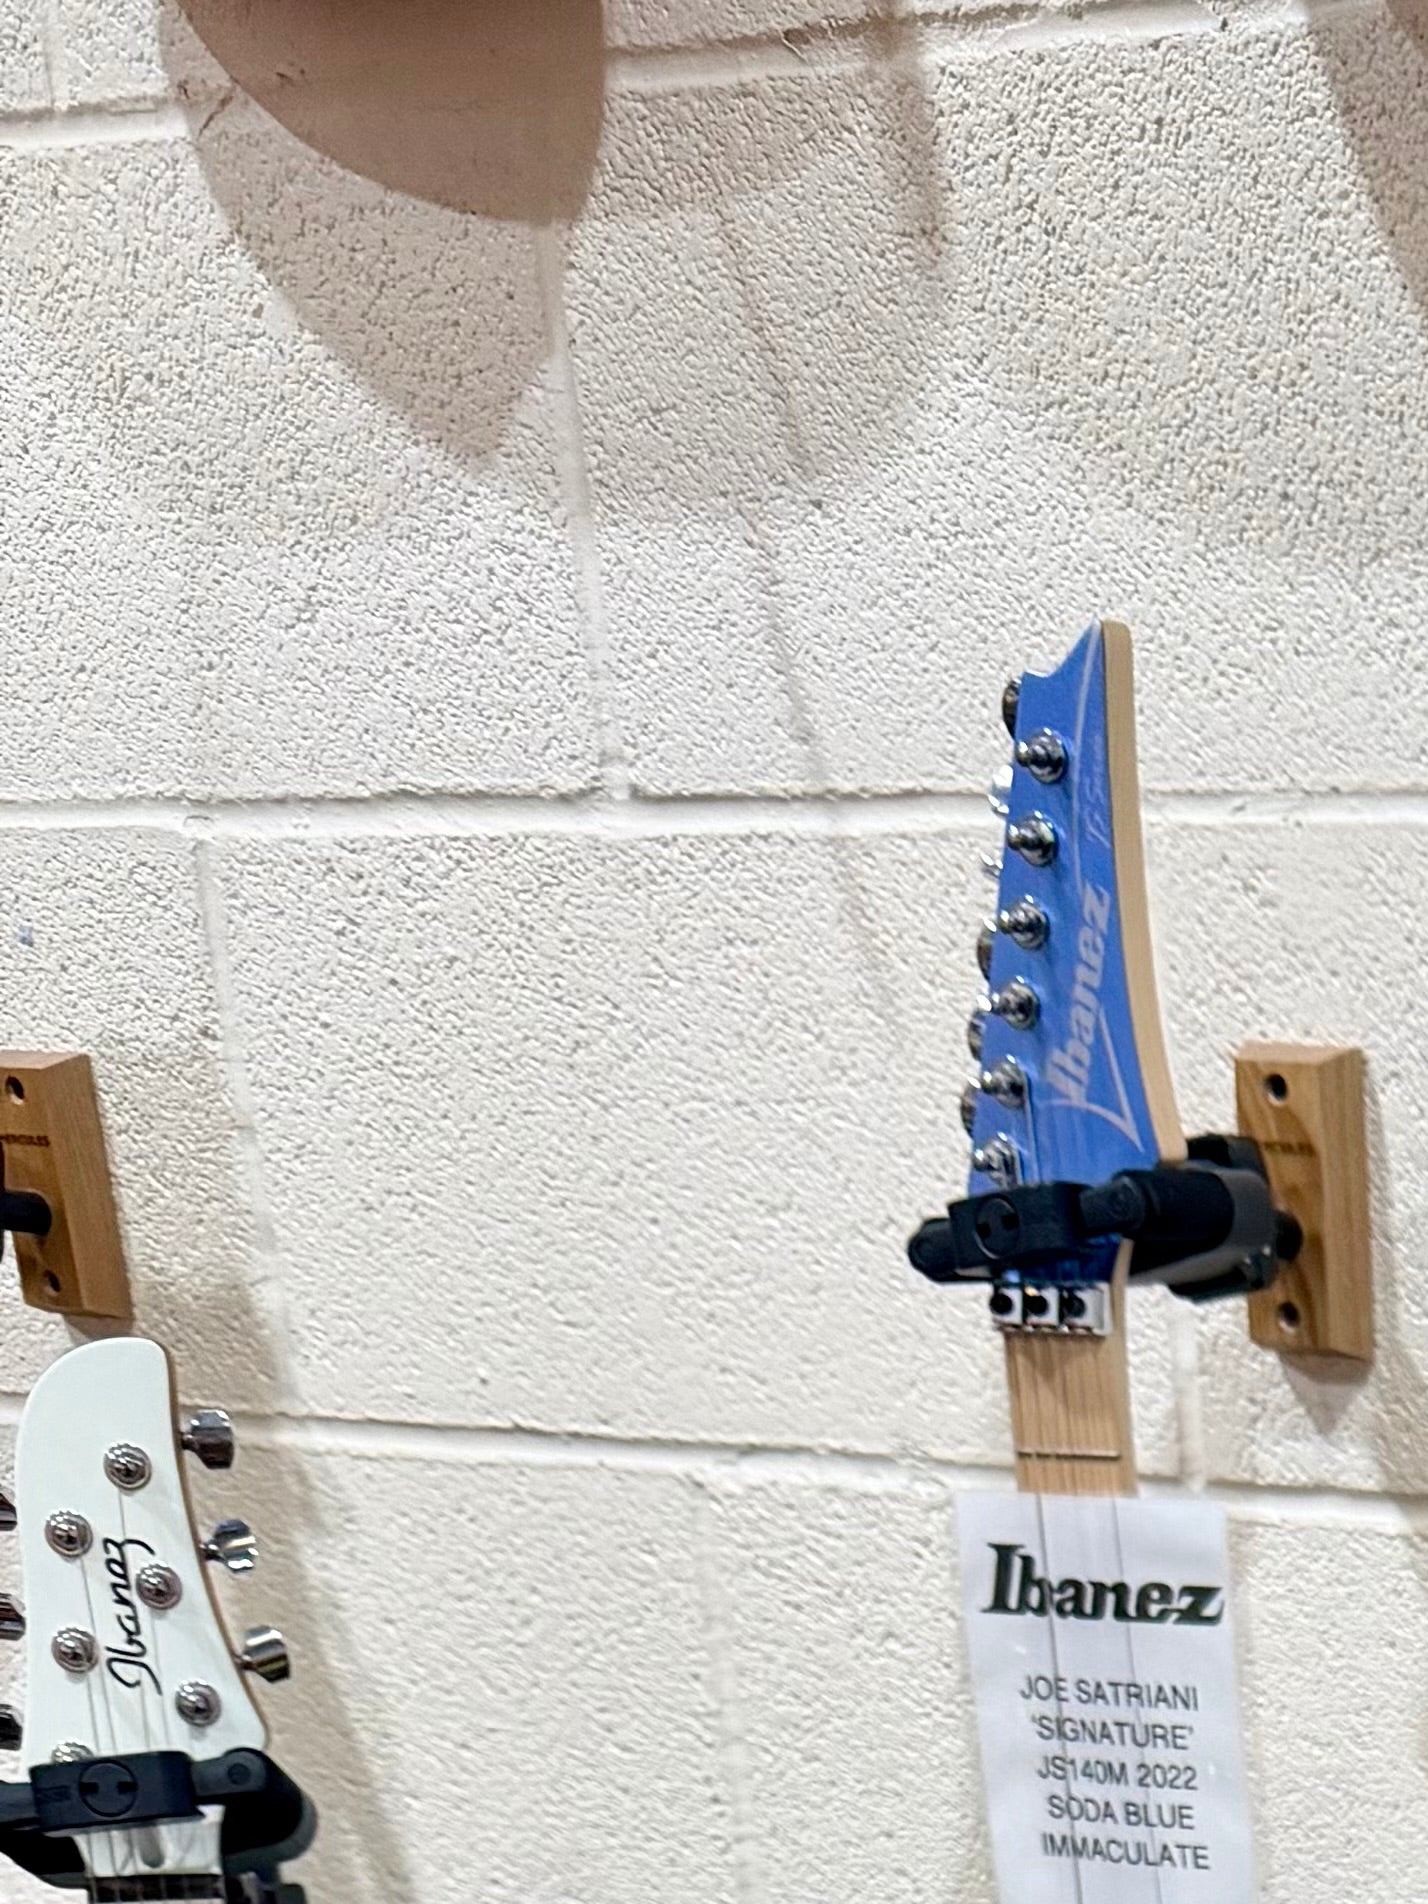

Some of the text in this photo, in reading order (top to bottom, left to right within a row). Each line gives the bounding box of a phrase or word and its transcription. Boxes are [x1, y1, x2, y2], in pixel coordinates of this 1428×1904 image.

[1045, 882, 1111, 1107] Ibanez
[980, 1542, 1224, 1626] Ibanez
[102, 1536, 163, 1696] Ibanez
[1019, 1677, 1199, 1712] JOE SATRIANI
[1037, 1756, 1198, 1790] JS140M 2022
[1047, 1795, 1195, 1830] SODA BLUE
[1042, 1833, 1210, 1871] IMMACULATE
